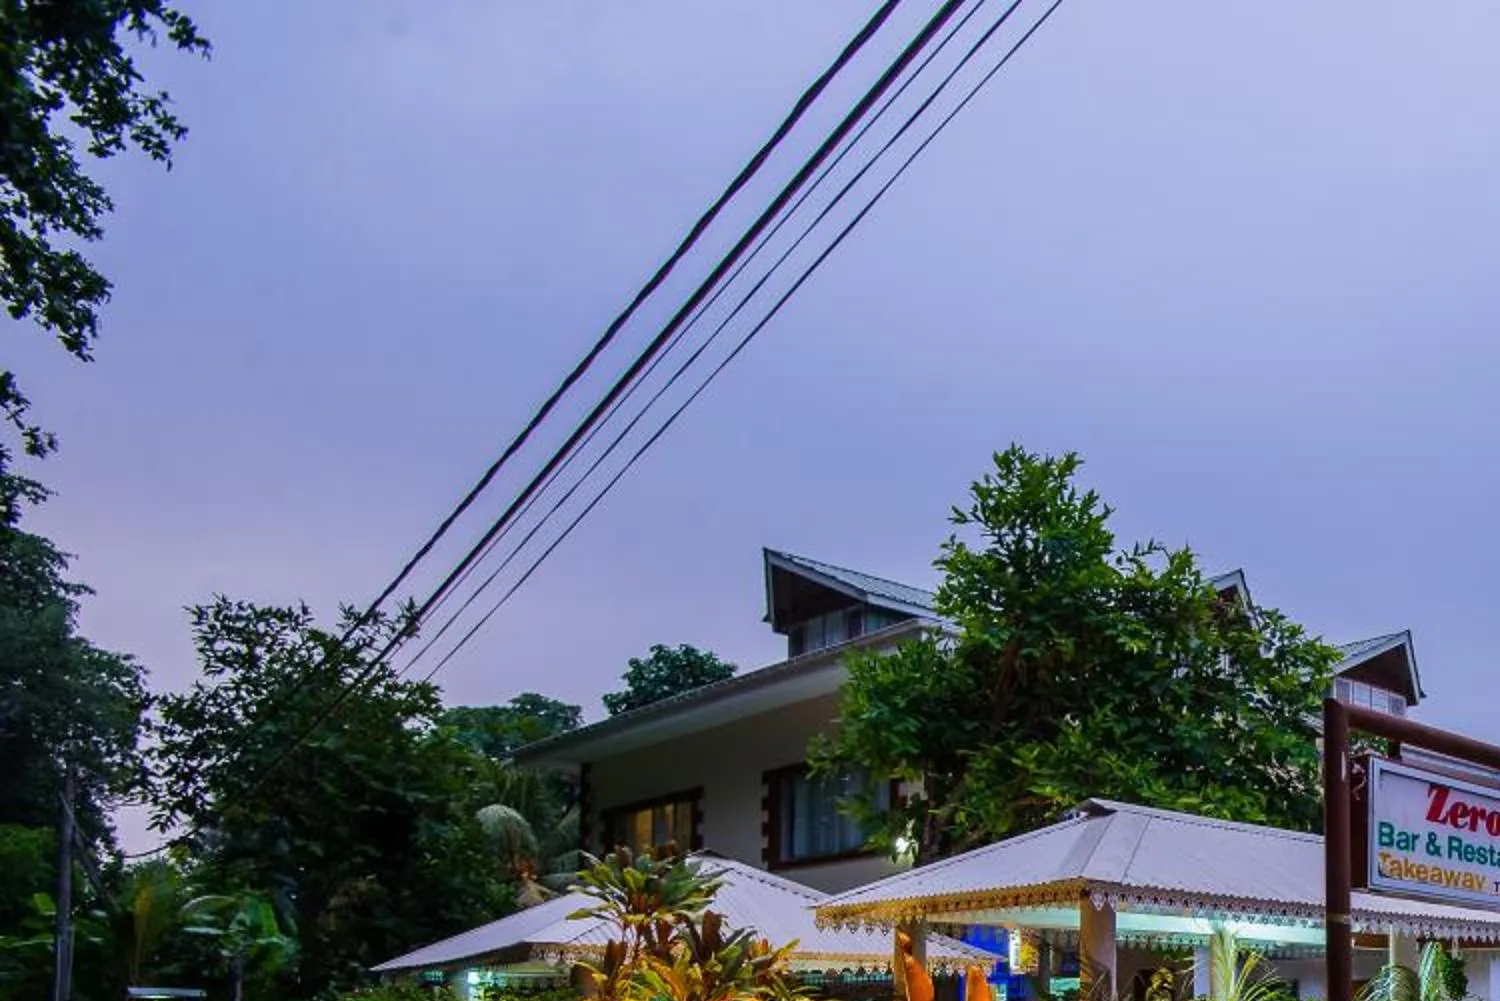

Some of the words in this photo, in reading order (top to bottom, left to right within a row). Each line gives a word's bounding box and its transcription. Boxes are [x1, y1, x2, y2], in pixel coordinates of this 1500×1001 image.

[1378, 821, 1420, 852] Bar
[1425, 831, 1442, 856] &
[1379, 852, 1486, 891] Takeaway
